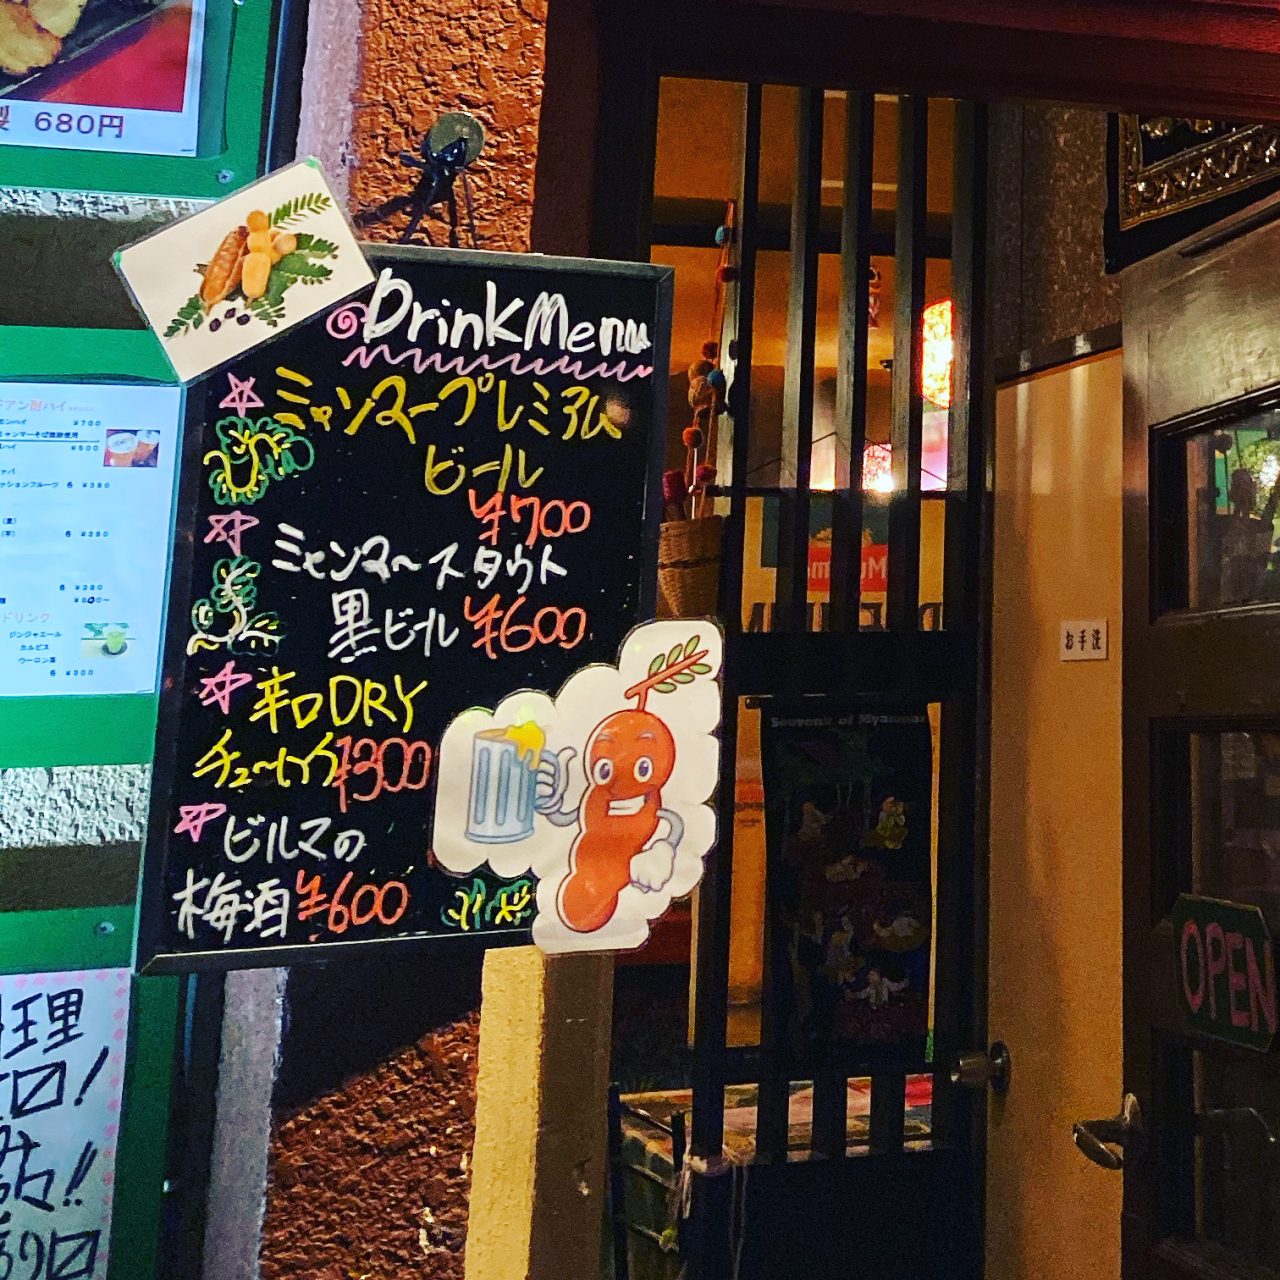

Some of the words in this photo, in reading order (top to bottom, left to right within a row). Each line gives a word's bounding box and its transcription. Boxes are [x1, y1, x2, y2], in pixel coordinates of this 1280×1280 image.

[34, 111, 124, 139] 680円
[424, 443, 544, 495] ビール
[468, 489, 591, 545] ¥700
[463, 593, 587, 660] ¥600
[223, 814, 367, 864] ビルマの
[173, 869, 291, 944] 梅酒
[294, 869, 410, 934] ¥600
[1180, 920, 1280, 1035] OPEN
